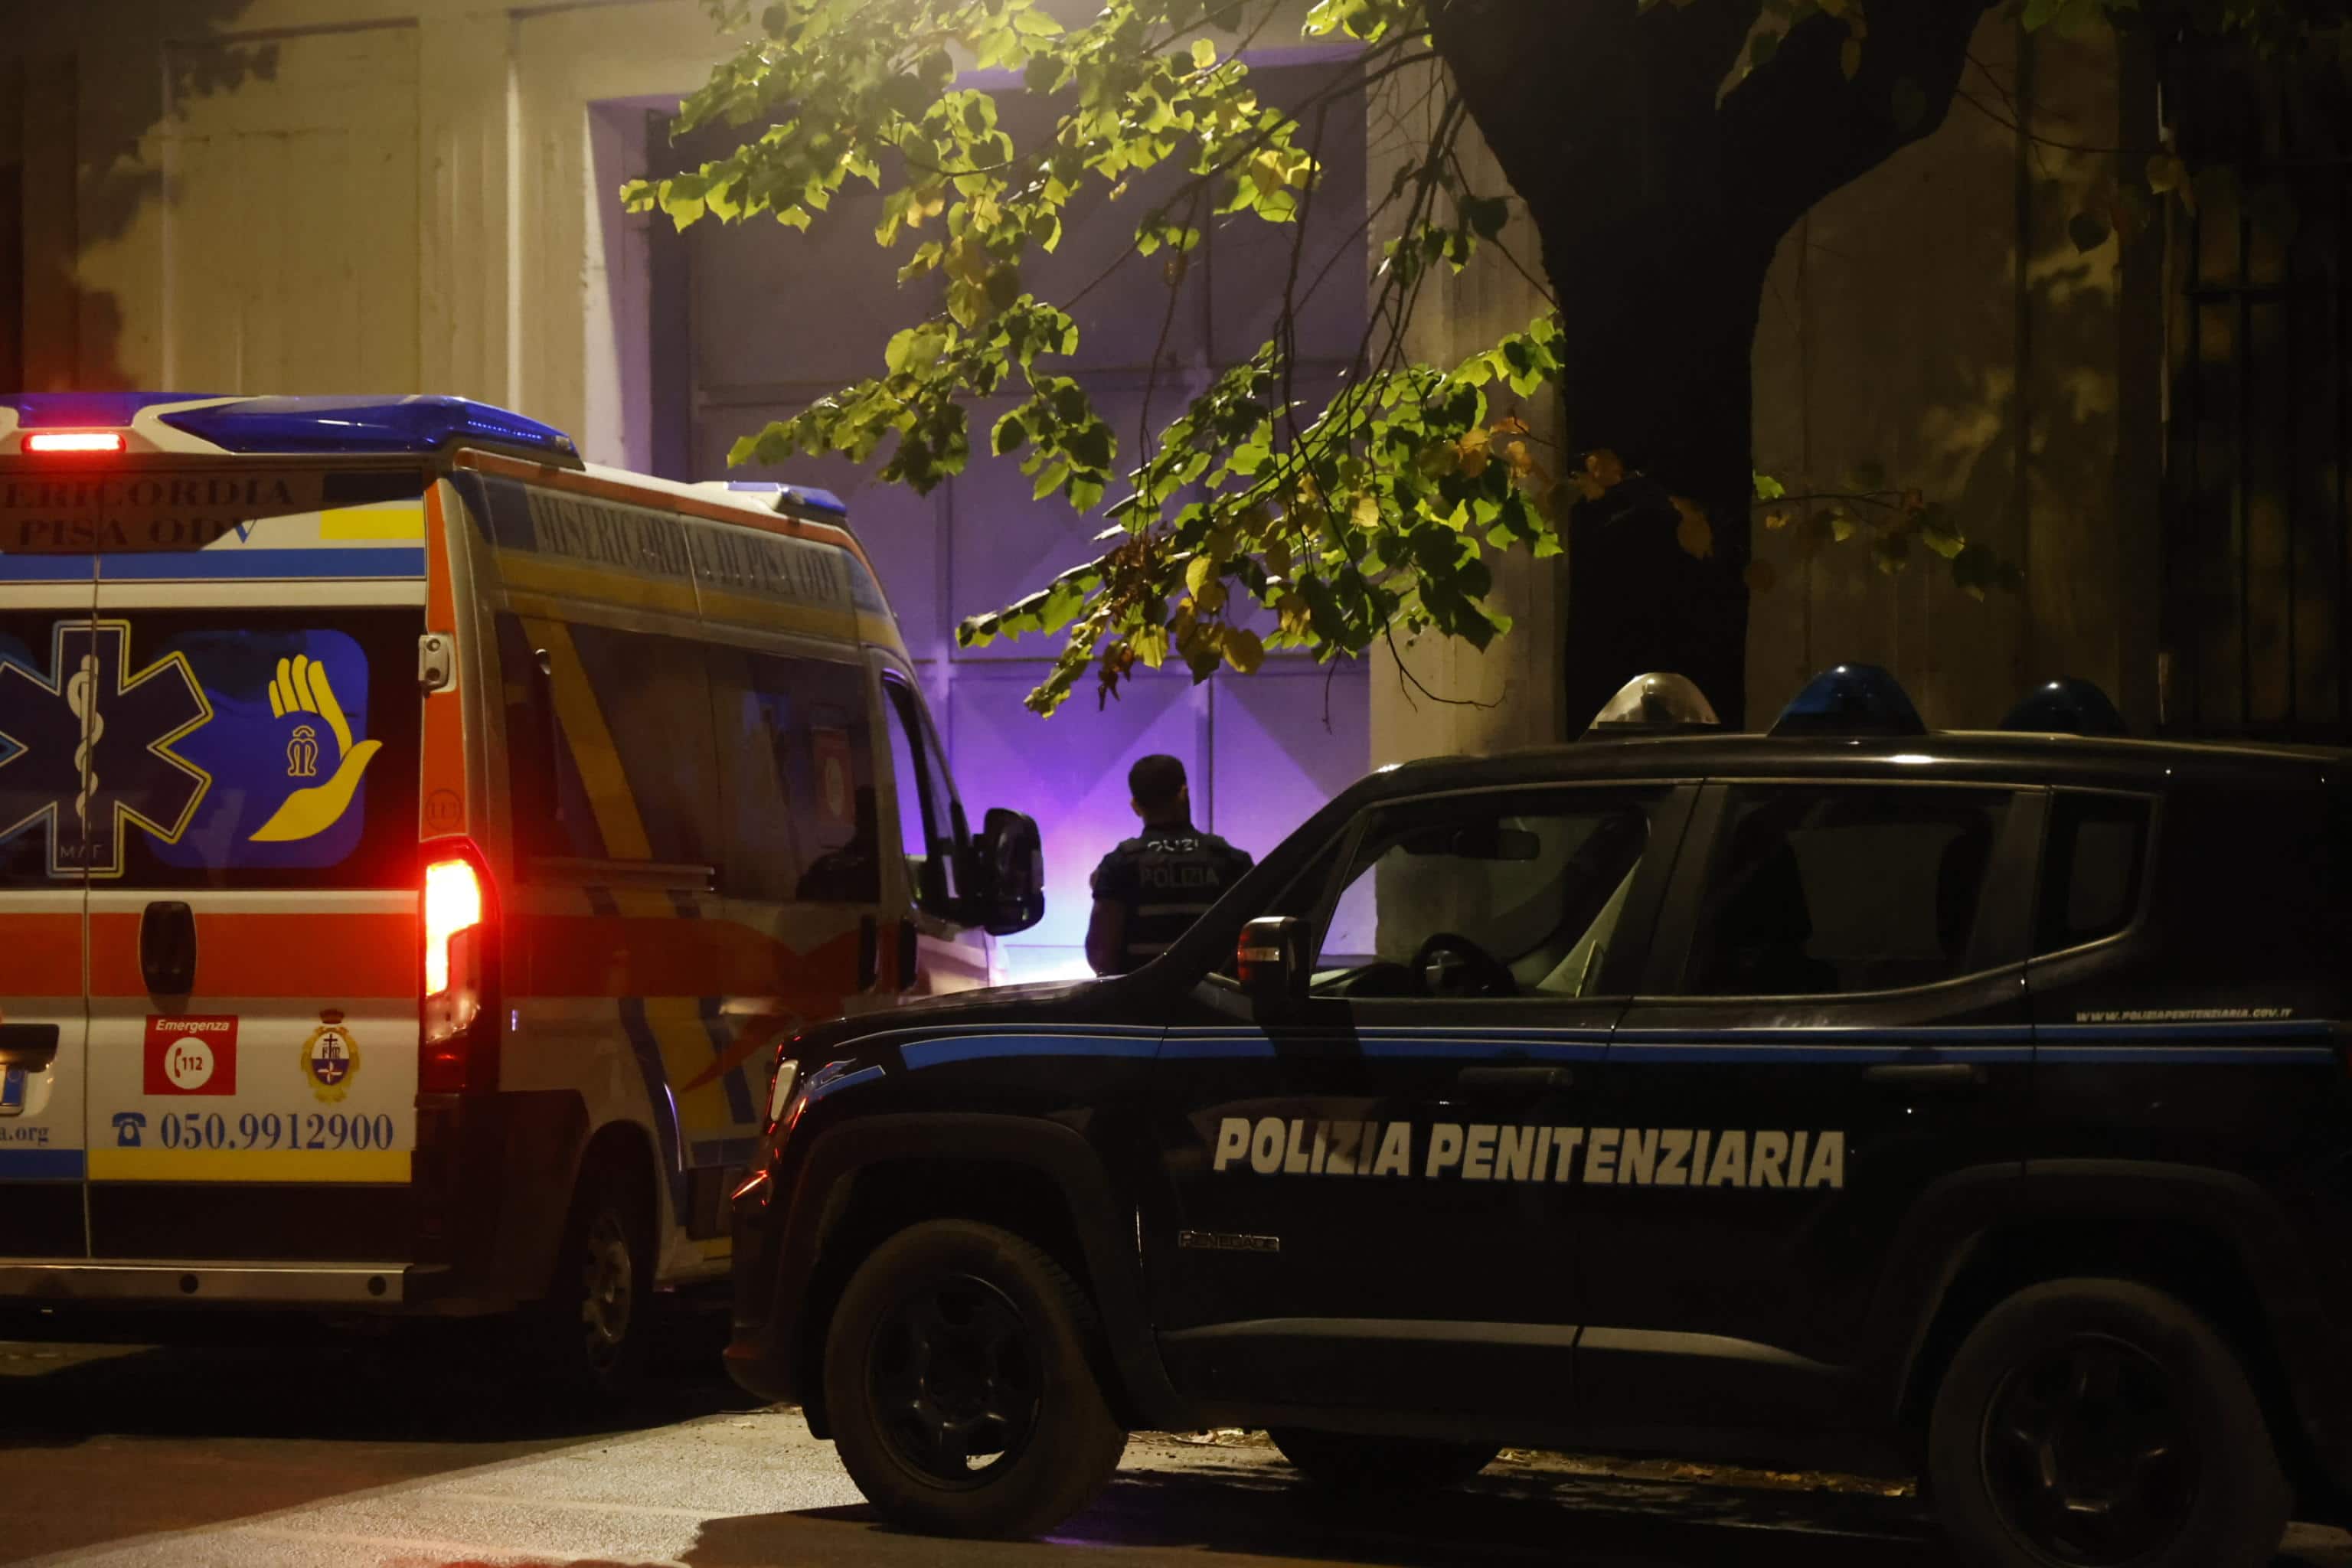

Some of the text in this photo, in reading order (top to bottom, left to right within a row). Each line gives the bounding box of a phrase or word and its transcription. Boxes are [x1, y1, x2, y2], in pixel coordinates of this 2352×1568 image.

[20, 518, 128, 546] PISA
[155, 1019, 230, 1034] Emergenza
[181, 1057, 203, 1071] 112
[160, 1112, 394, 1150] 050.9912900
[1212, 1116, 1845, 1190] POLIZIA PENITENZIARIA
